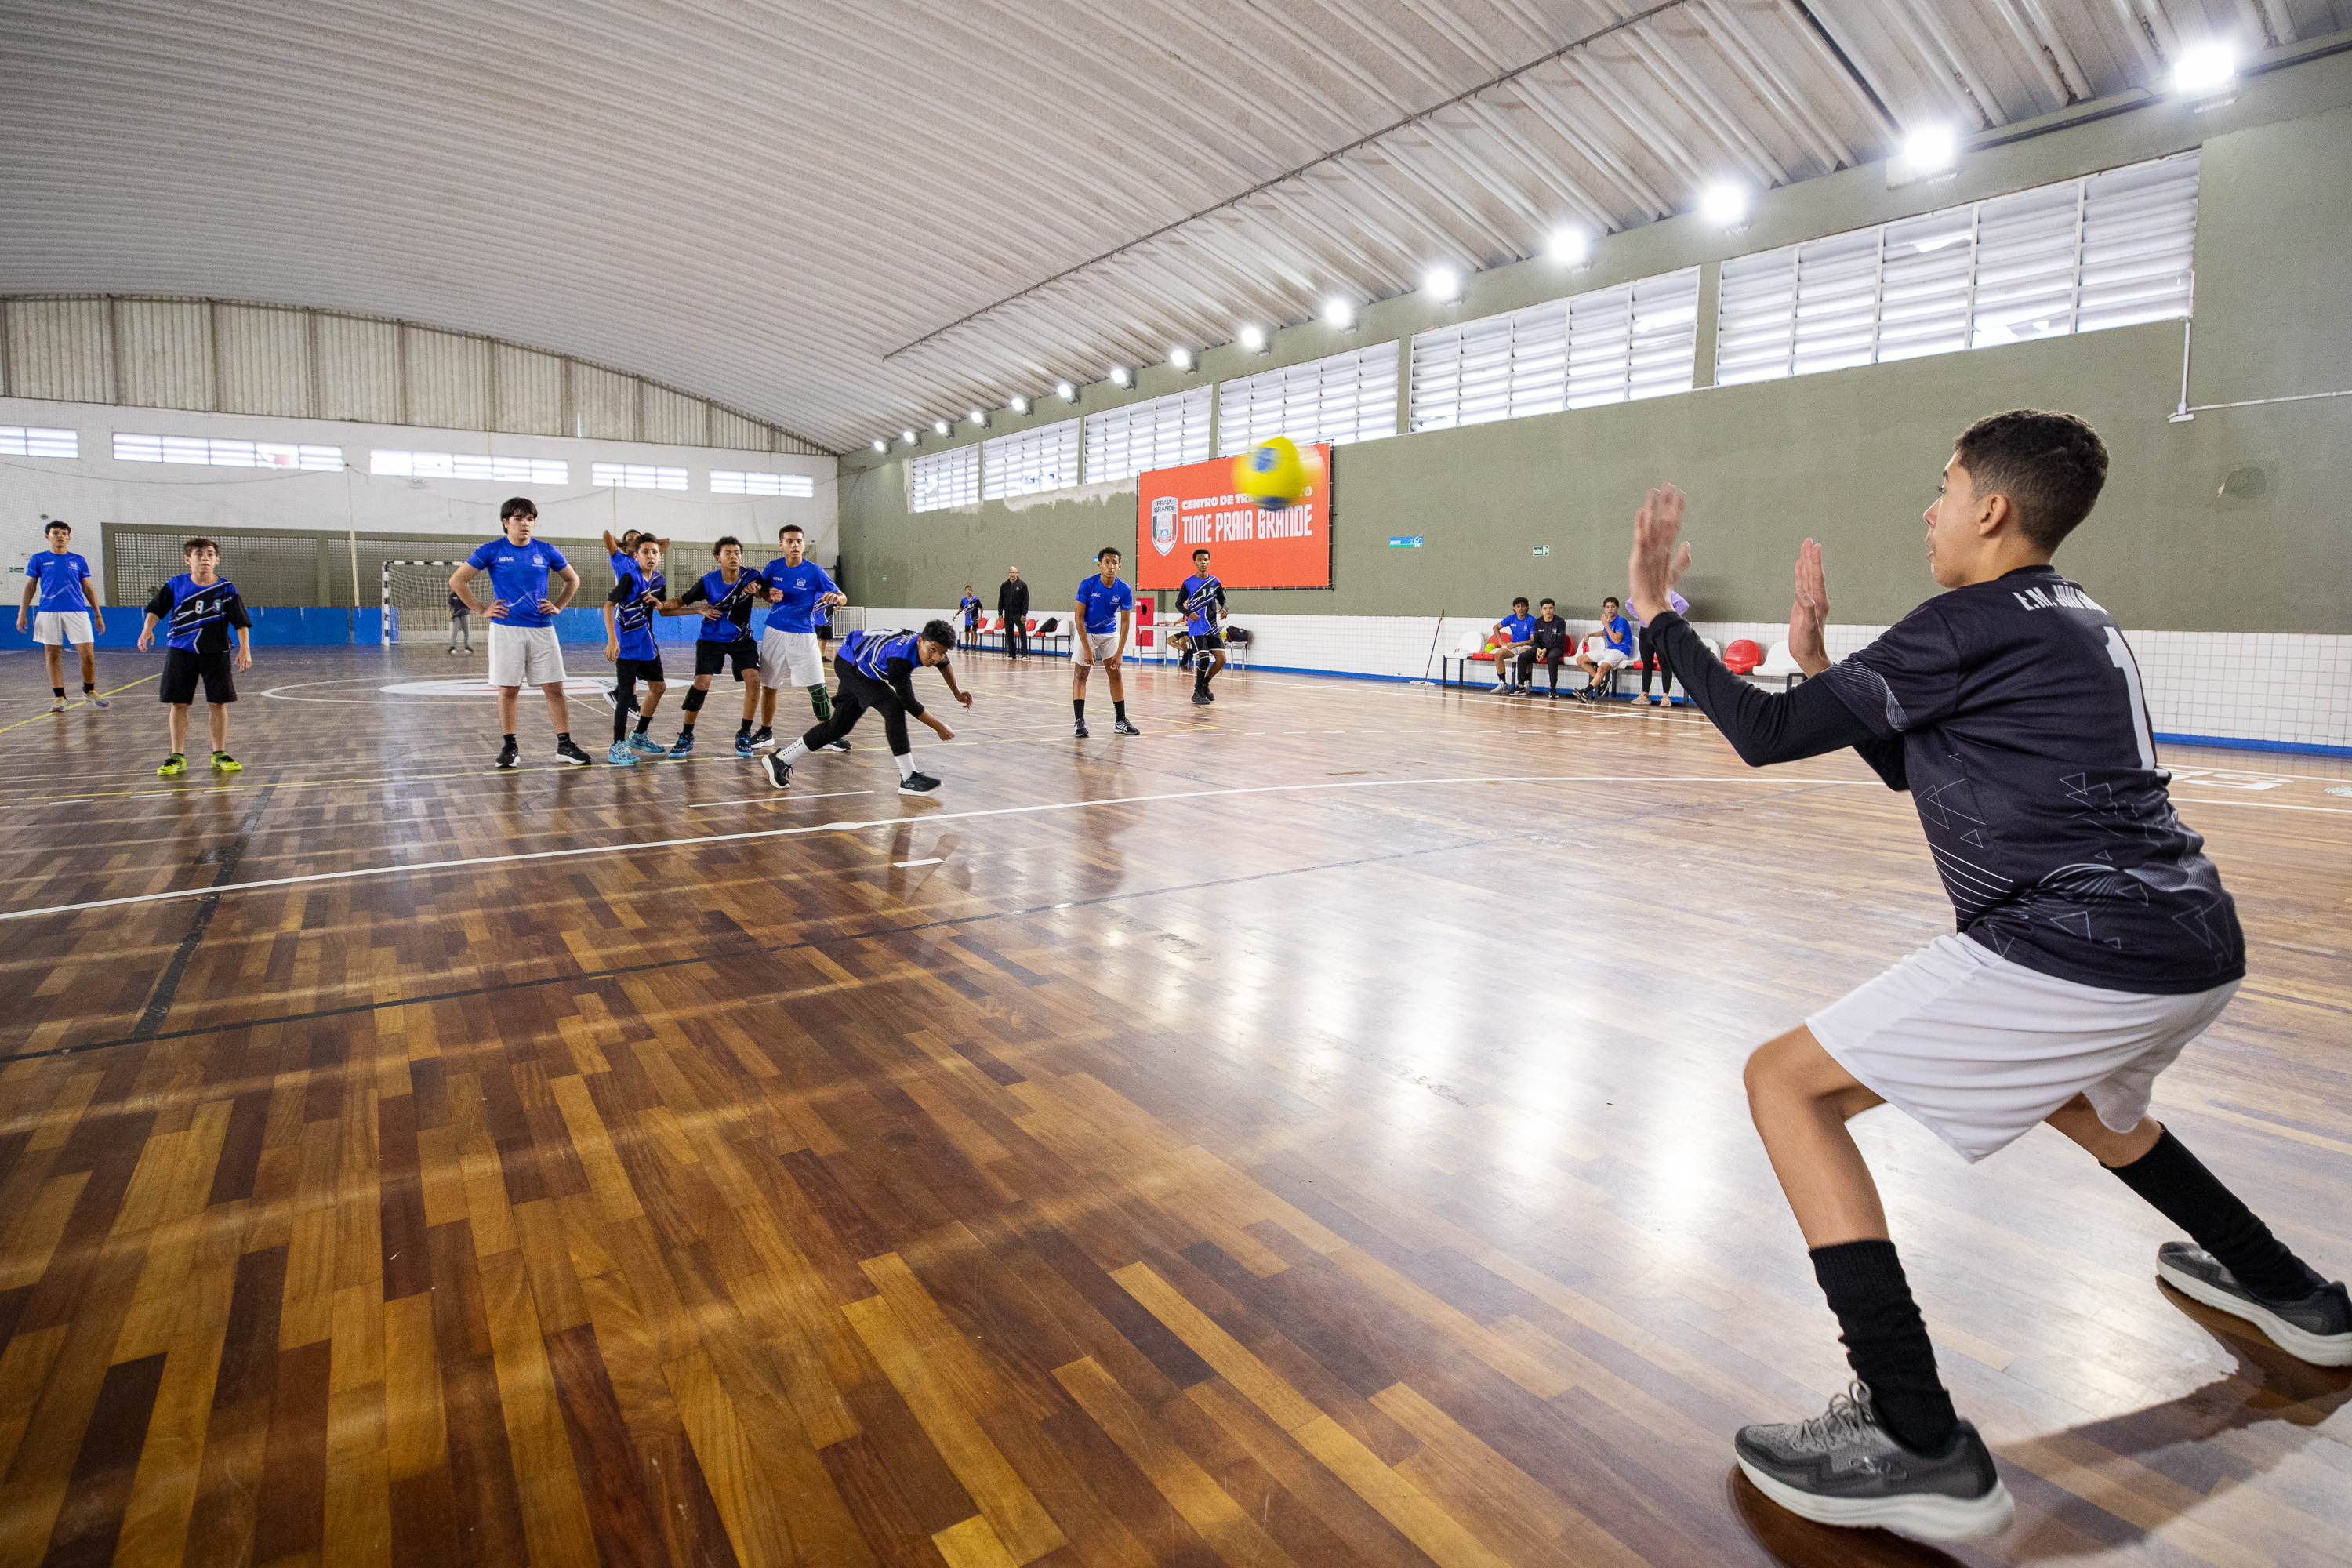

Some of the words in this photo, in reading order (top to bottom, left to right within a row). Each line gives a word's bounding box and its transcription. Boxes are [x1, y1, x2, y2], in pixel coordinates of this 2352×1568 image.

[1181, 496, 1218, 510] CENTRO
[1220, 494, 1235, 506] DE
[1181, 514, 1212, 544] TIME
[1215, 510, 1253, 543] PRAIA
[1257, 504, 1313, 539] GRANDE
[195, 600, 204, 614] 8
[2012, 586, 2058, 611] E.M.
[2103, 626, 2171, 778] 1
